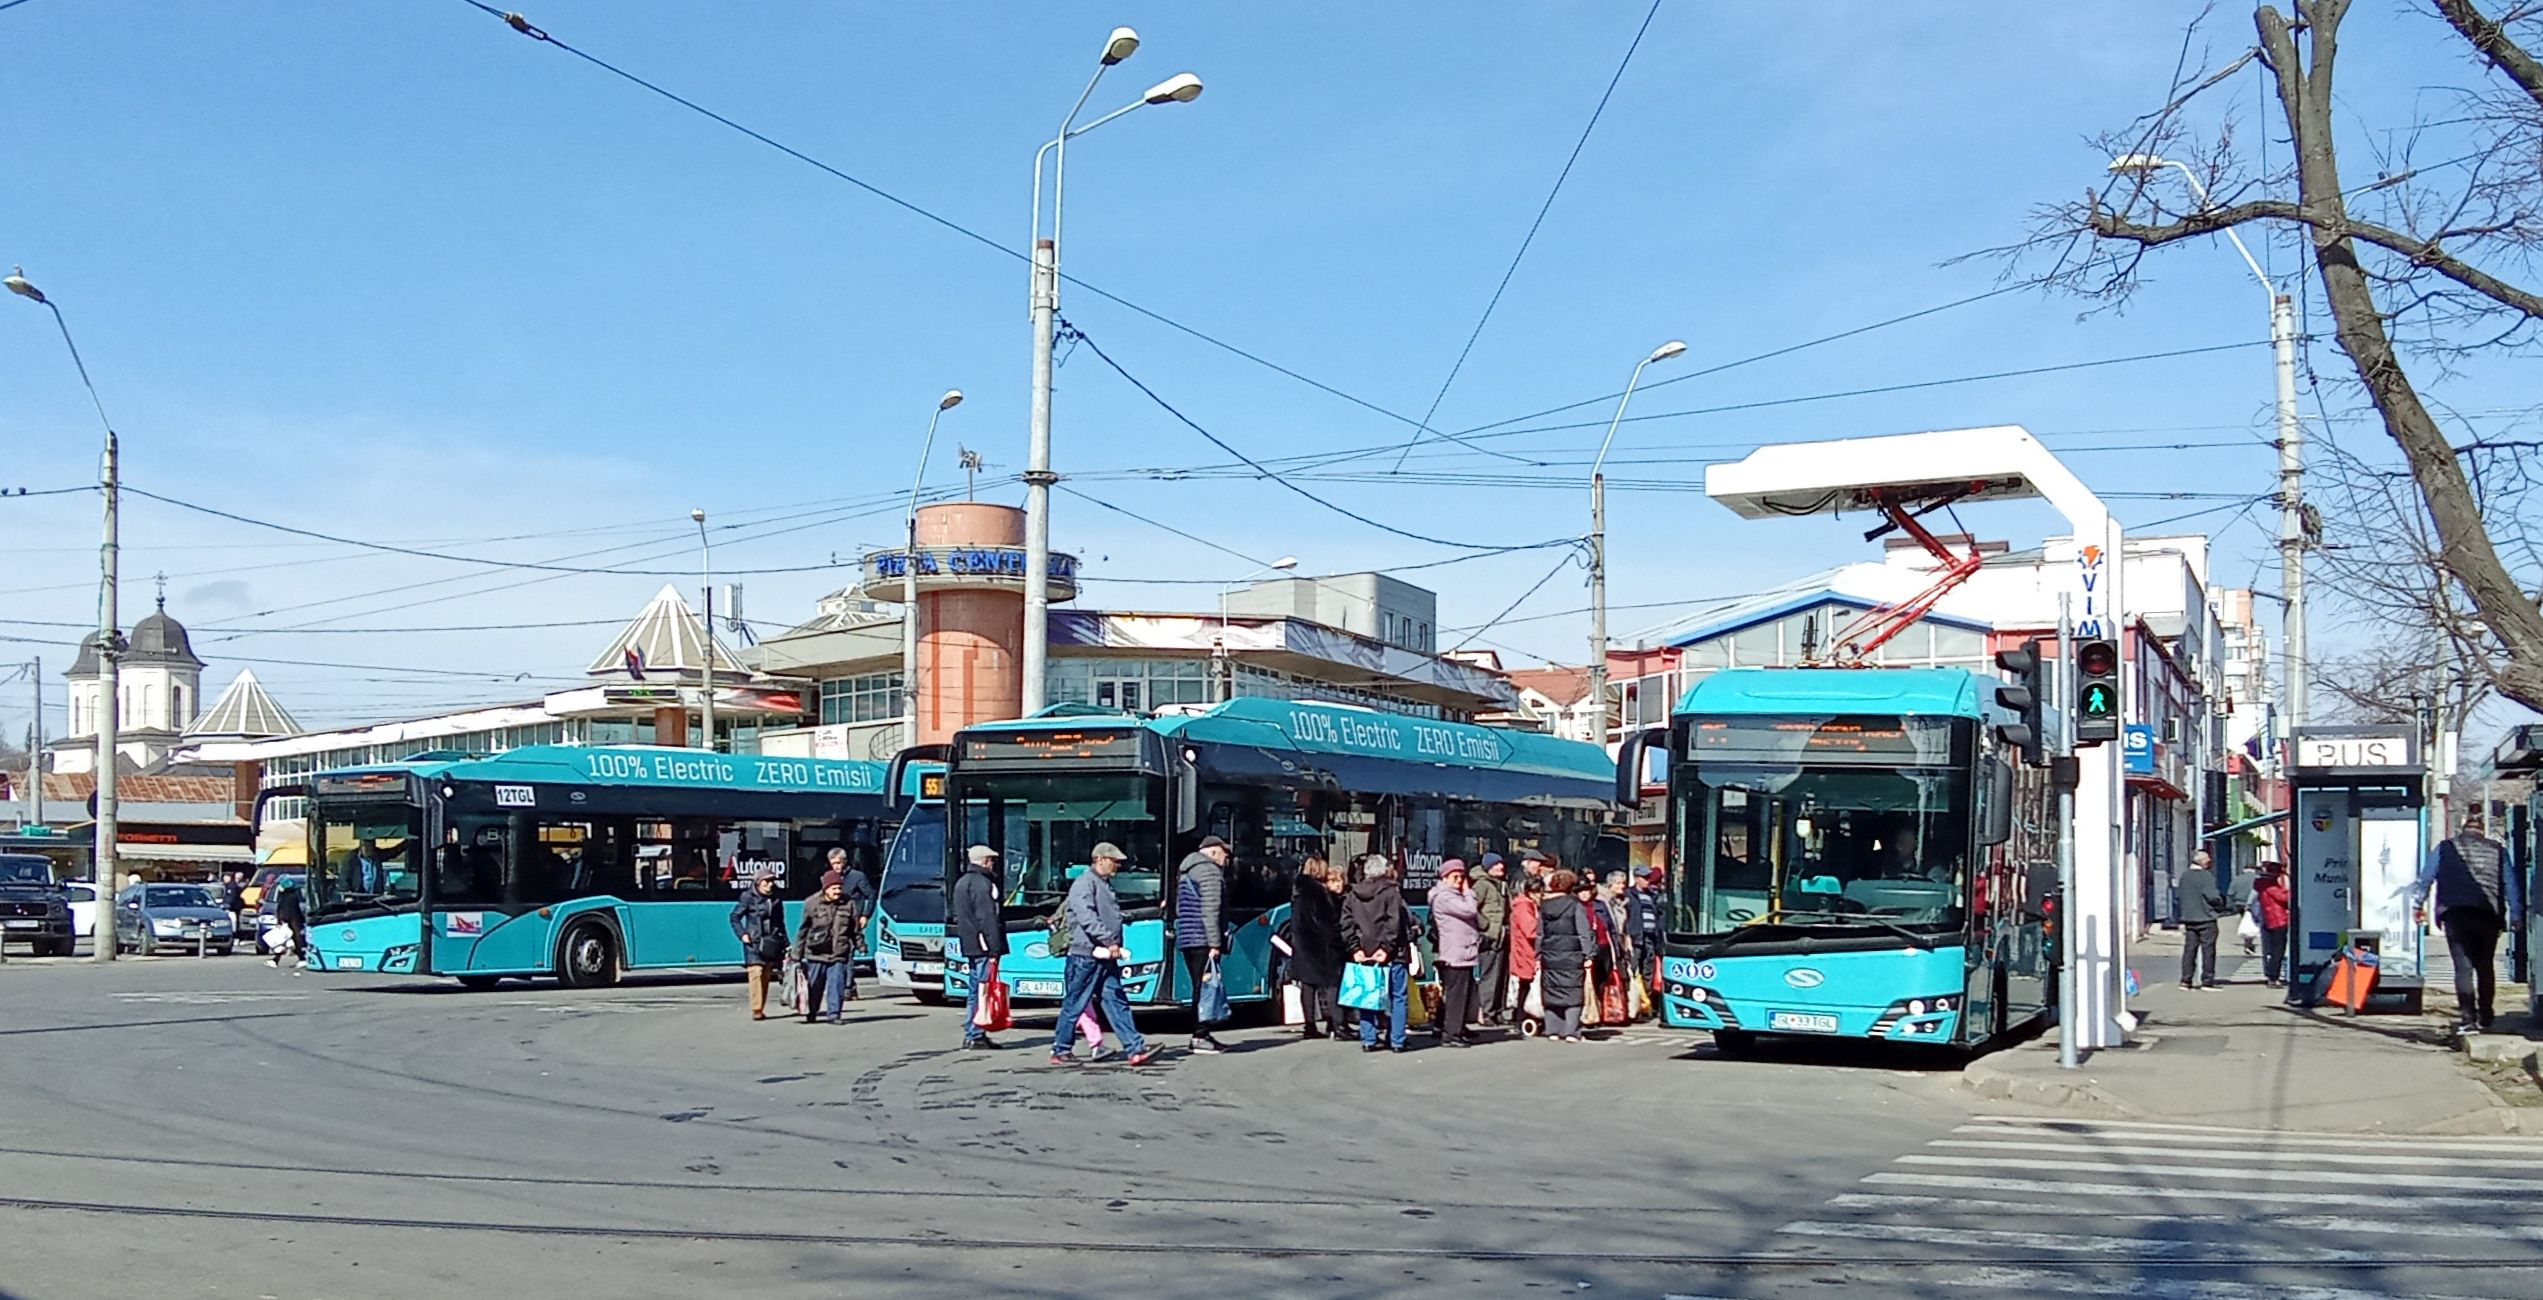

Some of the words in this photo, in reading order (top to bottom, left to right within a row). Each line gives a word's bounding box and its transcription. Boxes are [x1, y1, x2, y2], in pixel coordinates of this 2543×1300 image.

[1289, 711, 1338, 744] 100%
[1341, 716, 1401, 750] Electric
[1413, 726, 1454, 756] ZERO
[1457, 731, 1500, 761] Emisii
[2317, 742, 2388, 767] BUS
[587, 754, 647, 779] 100%
[655, 756, 734, 783] Electric
[754, 761, 808, 785] ZERO
[815, 763, 872, 788] Emisii
[497, 788, 535, 803] 12TGL
